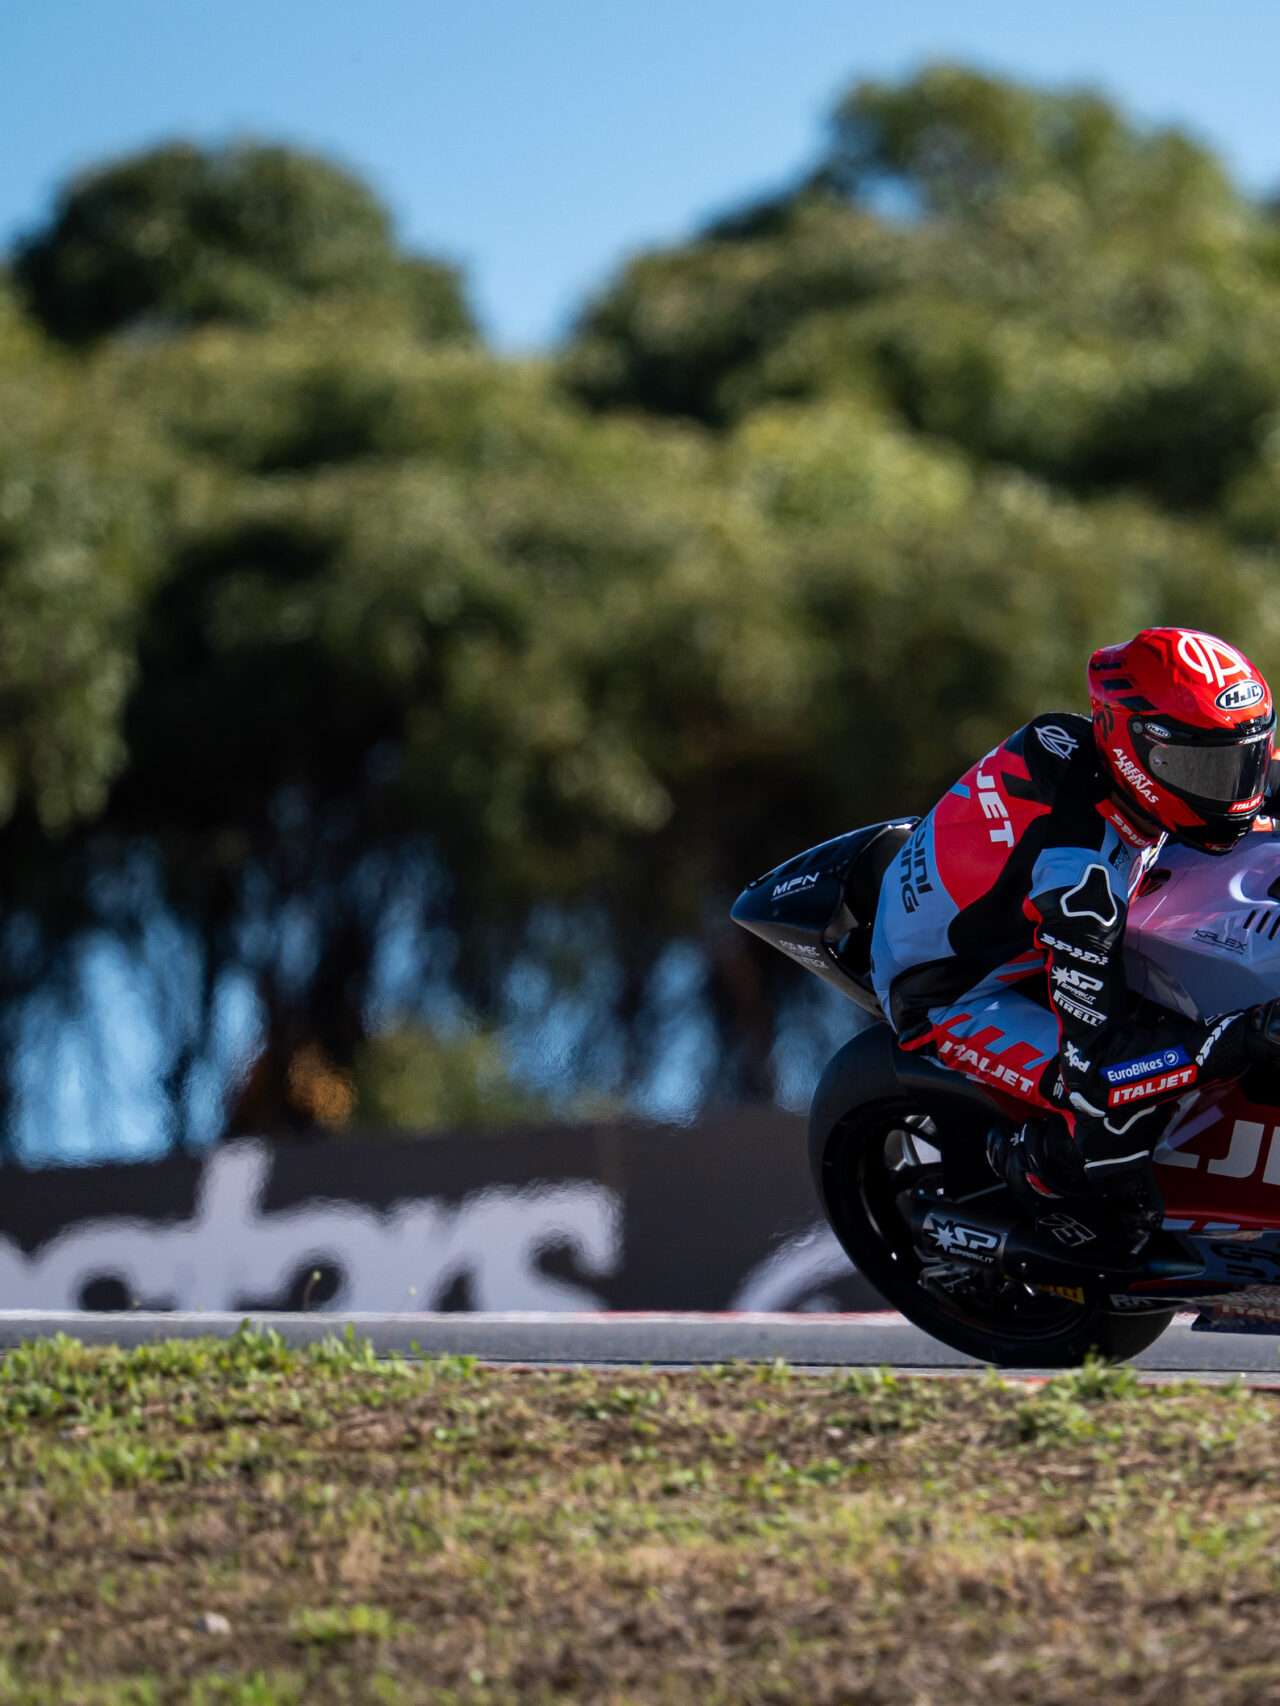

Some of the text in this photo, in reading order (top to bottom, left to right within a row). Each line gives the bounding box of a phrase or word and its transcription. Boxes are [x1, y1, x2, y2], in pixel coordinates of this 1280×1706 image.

[1224, 683, 1260, 707] HJC
[939, 1040, 1034, 1093] ITALJET
[1107, 1057, 1164, 1081] EuroBikes
[1112, 1070, 1192, 1104] ITALJET
